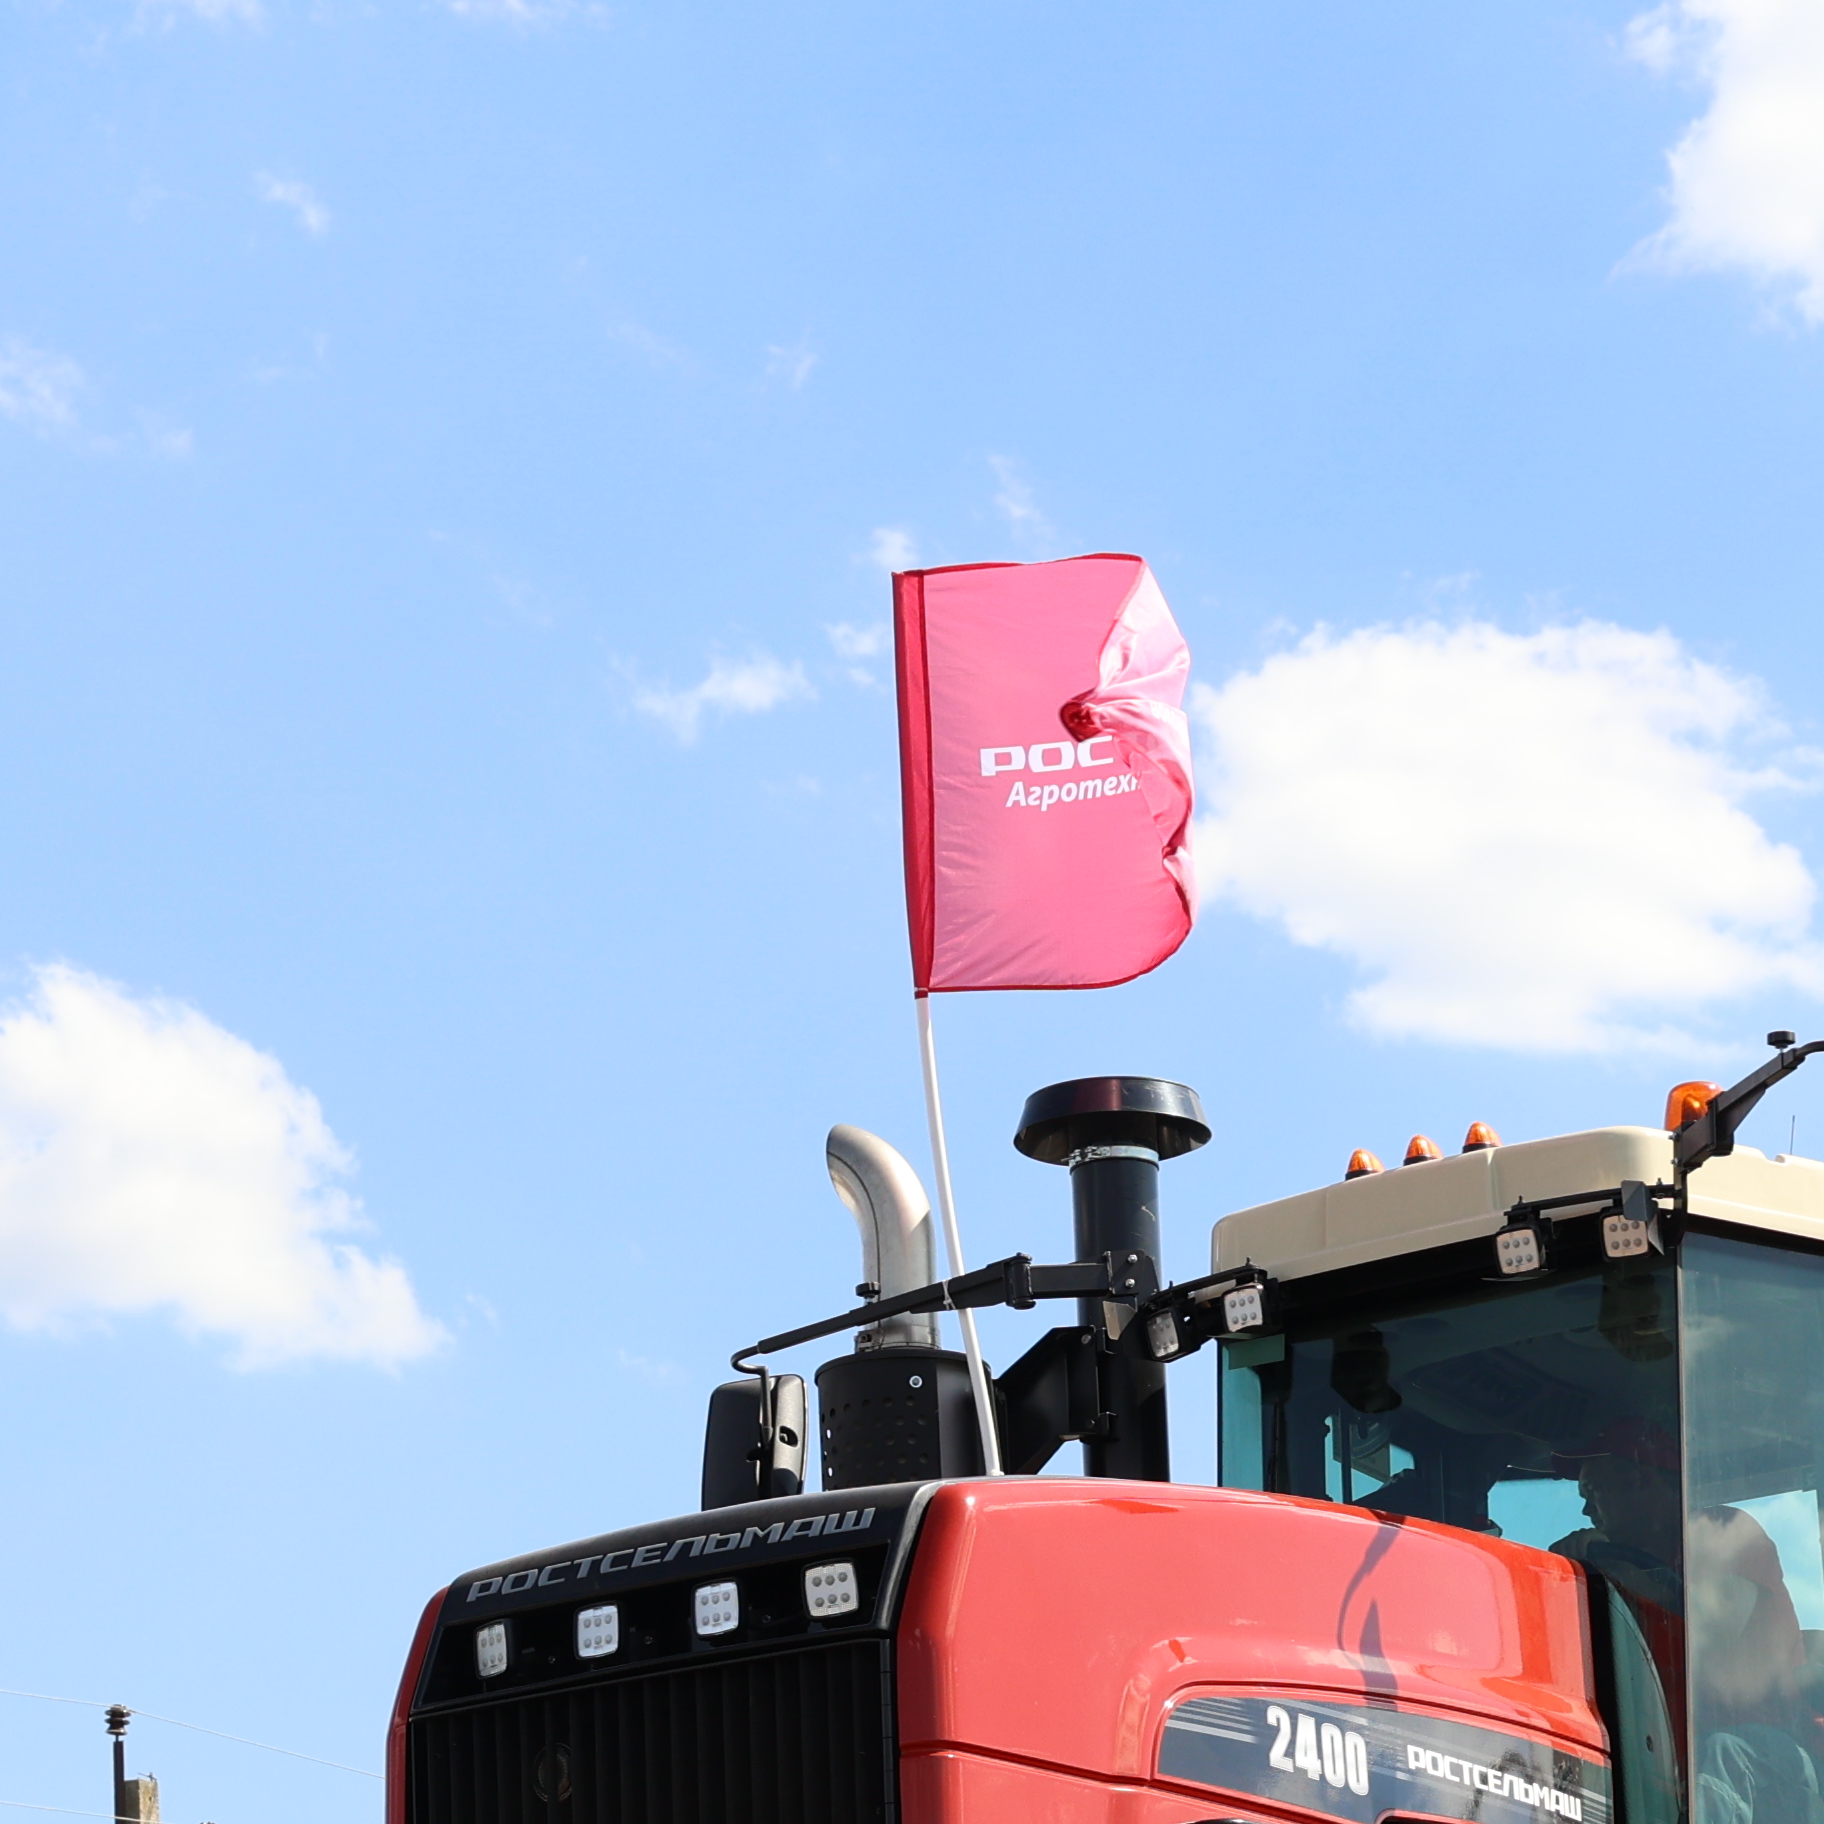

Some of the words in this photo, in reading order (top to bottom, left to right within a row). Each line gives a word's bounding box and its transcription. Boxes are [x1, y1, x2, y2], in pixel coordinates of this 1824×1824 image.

[979, 735, 1115, 777] РОС
[465, 1506, 877, 1603] РОСТСЕЛЬМАШ
[1266, 1705, 1370, 1797] 2400
[1406, 1743, 1583, 1823] РОСТСЕЛЬМАШ
